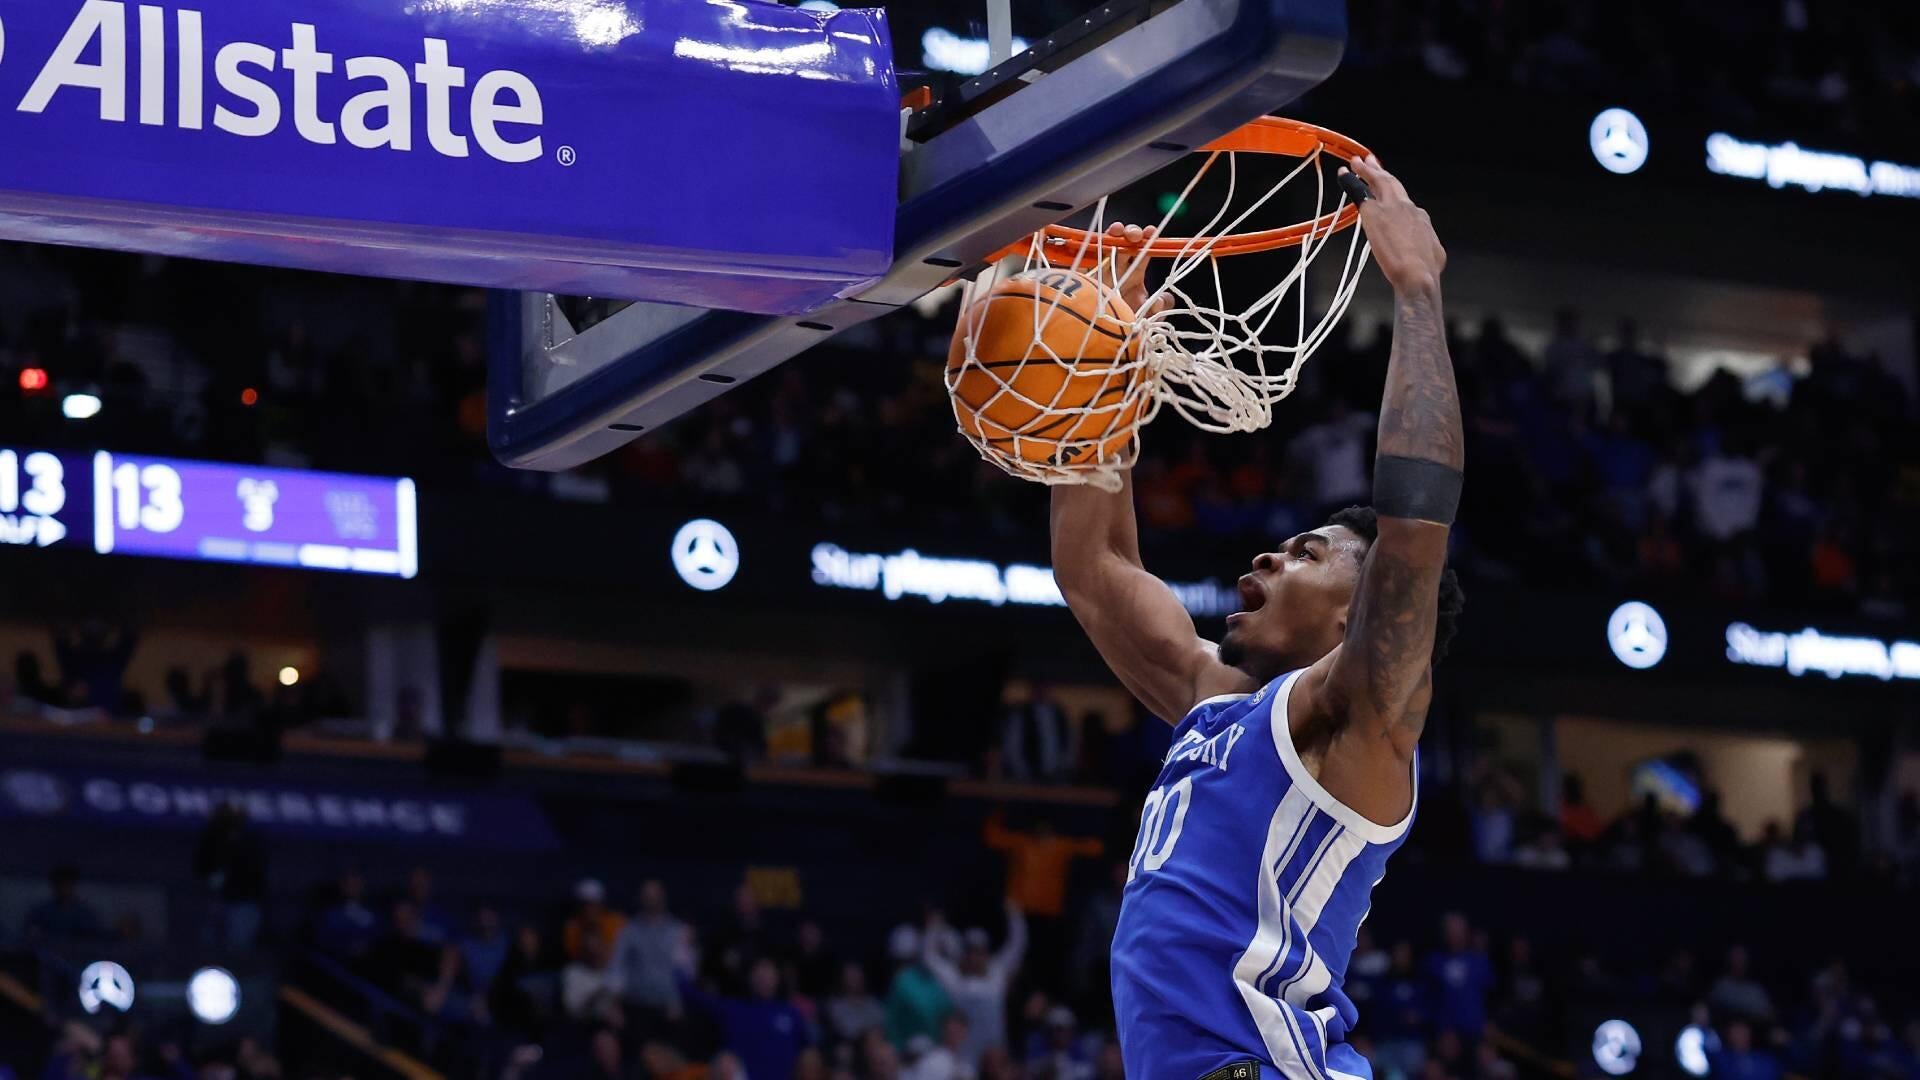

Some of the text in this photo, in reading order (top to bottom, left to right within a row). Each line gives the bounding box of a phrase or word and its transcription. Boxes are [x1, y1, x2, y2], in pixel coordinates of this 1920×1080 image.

[16, 0, 544, 163] Allstate
[113, 462, 184, 533] 13
[1127, 775, 1193, 883] 00
[1233, 1067, 1247, 1079] 46
